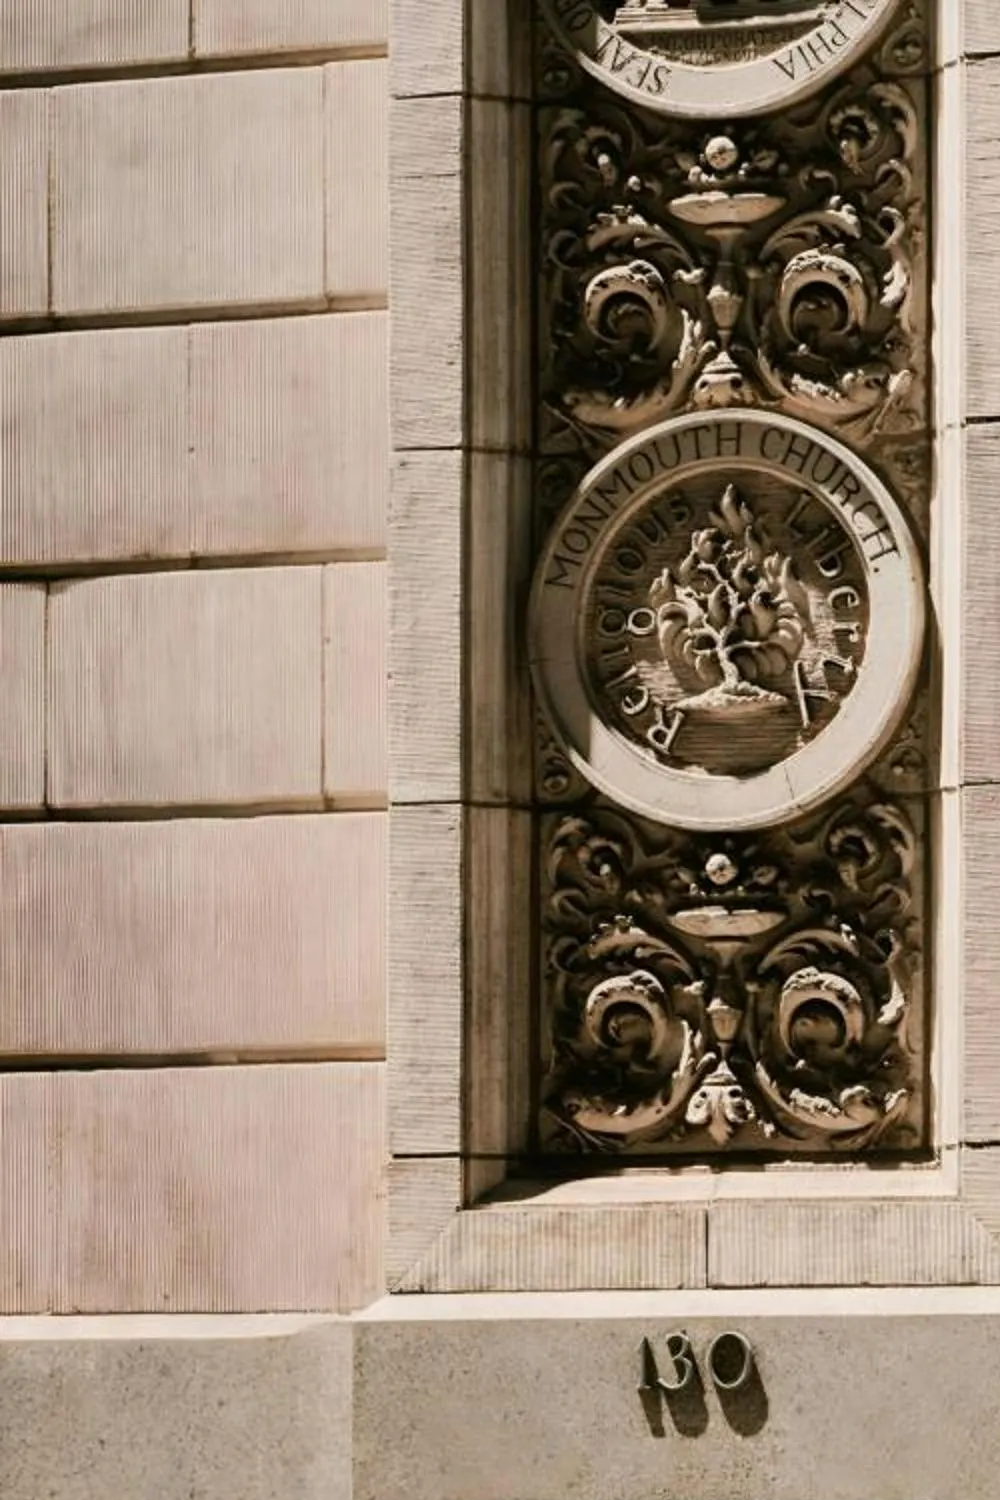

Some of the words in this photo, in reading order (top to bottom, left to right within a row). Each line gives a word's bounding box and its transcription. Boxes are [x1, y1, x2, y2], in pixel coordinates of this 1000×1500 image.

[592, 26, 673, 96] SEAL
[772, 0, 877, 80] LPHIA
[545, 422, 742, 592] MONMOUTH
[637, 1331, 753, 1389] 130
